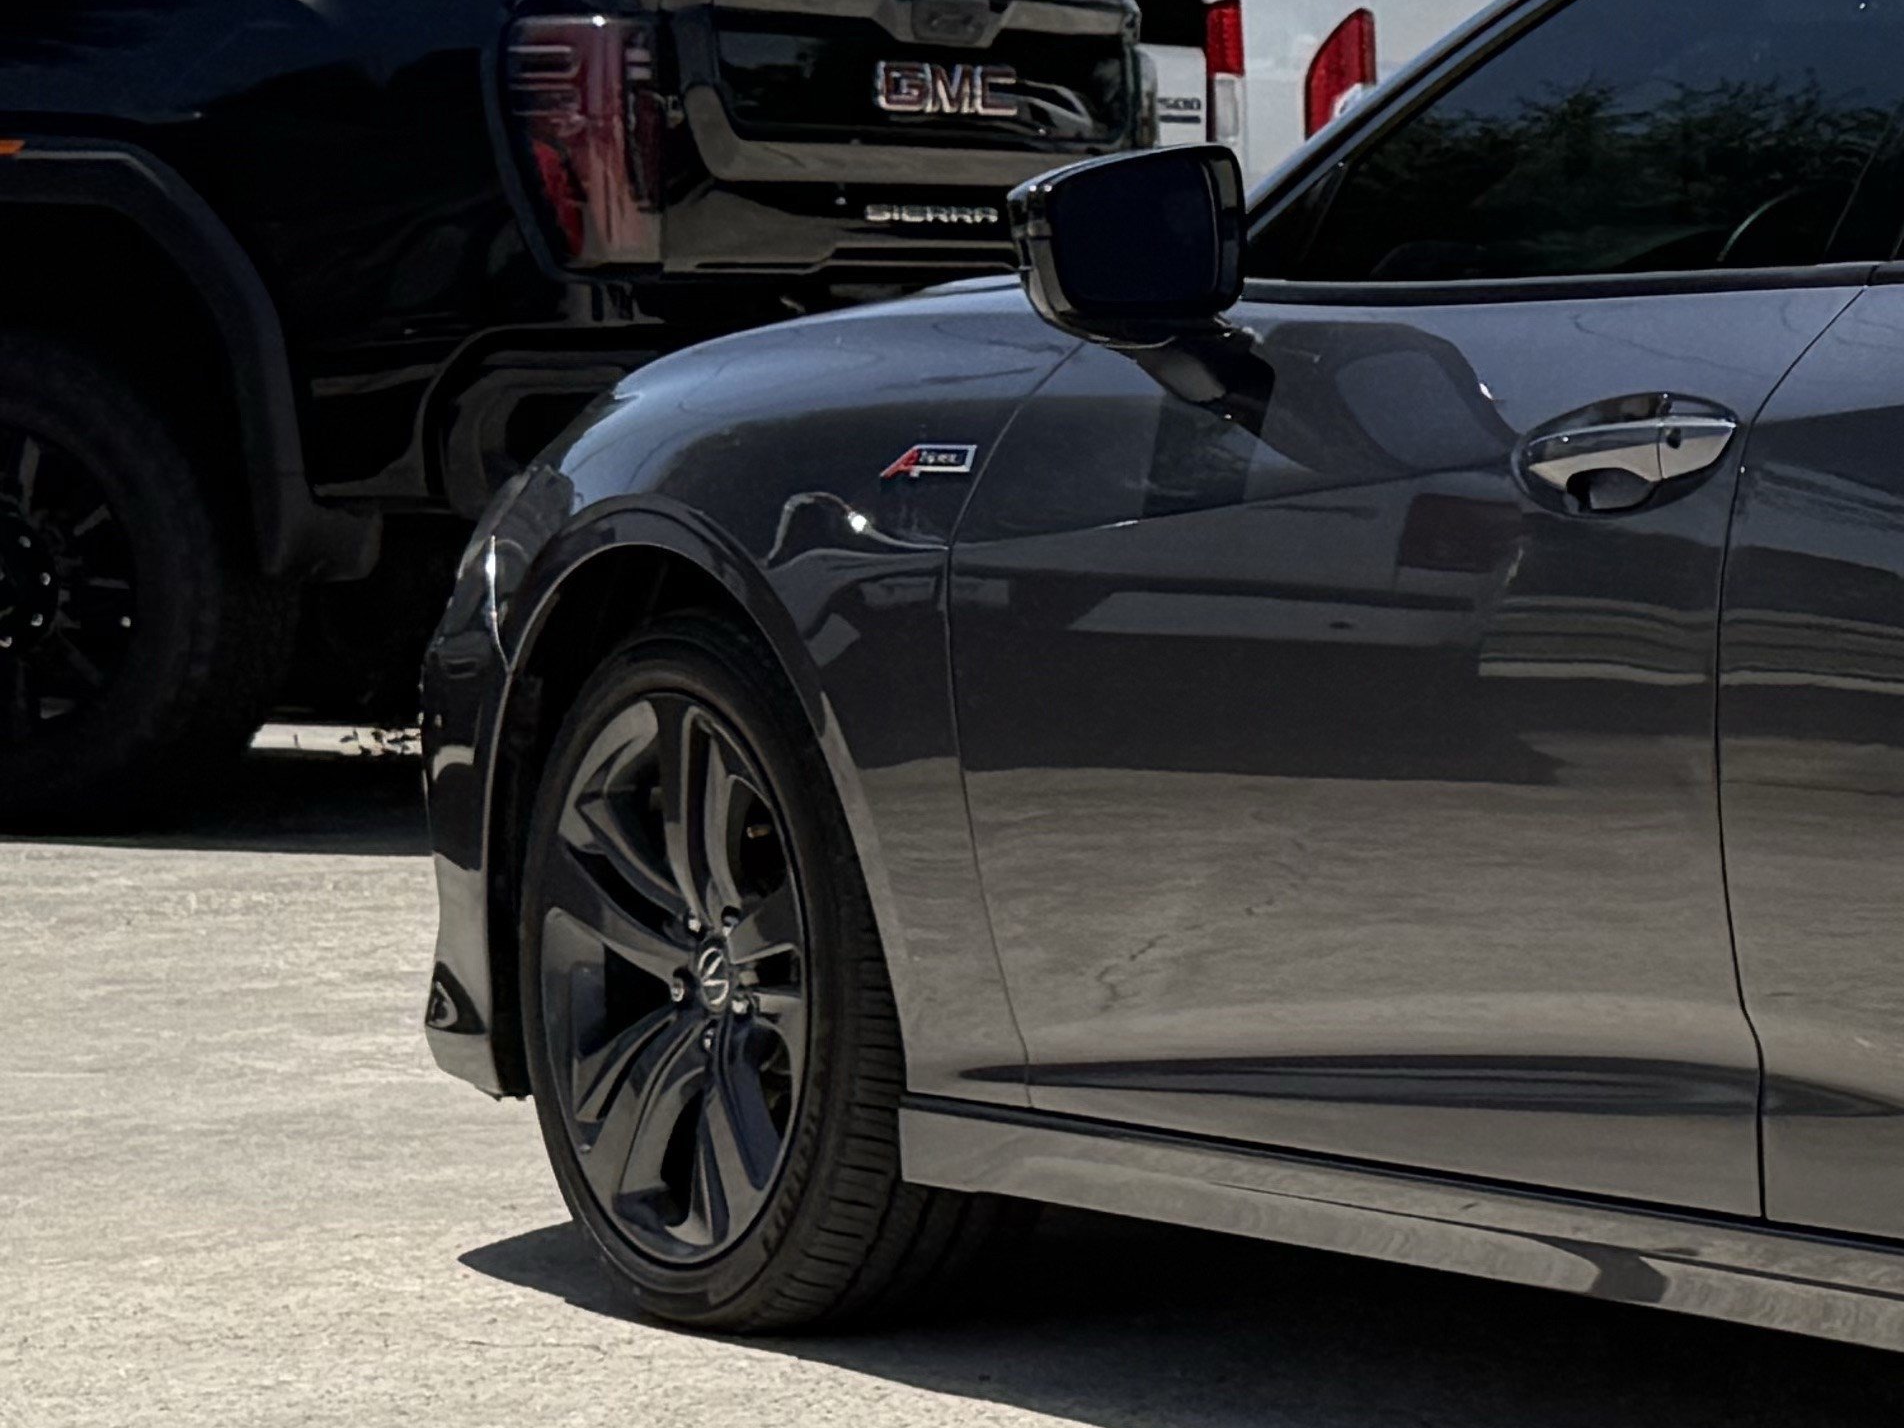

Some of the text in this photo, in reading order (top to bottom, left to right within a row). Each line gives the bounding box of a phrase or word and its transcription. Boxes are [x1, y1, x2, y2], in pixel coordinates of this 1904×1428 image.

[877, 60, 1017, 116] GMC
[1159, 97, 1201, 110] 500
[865, 204, 998, 223] SIERRA
